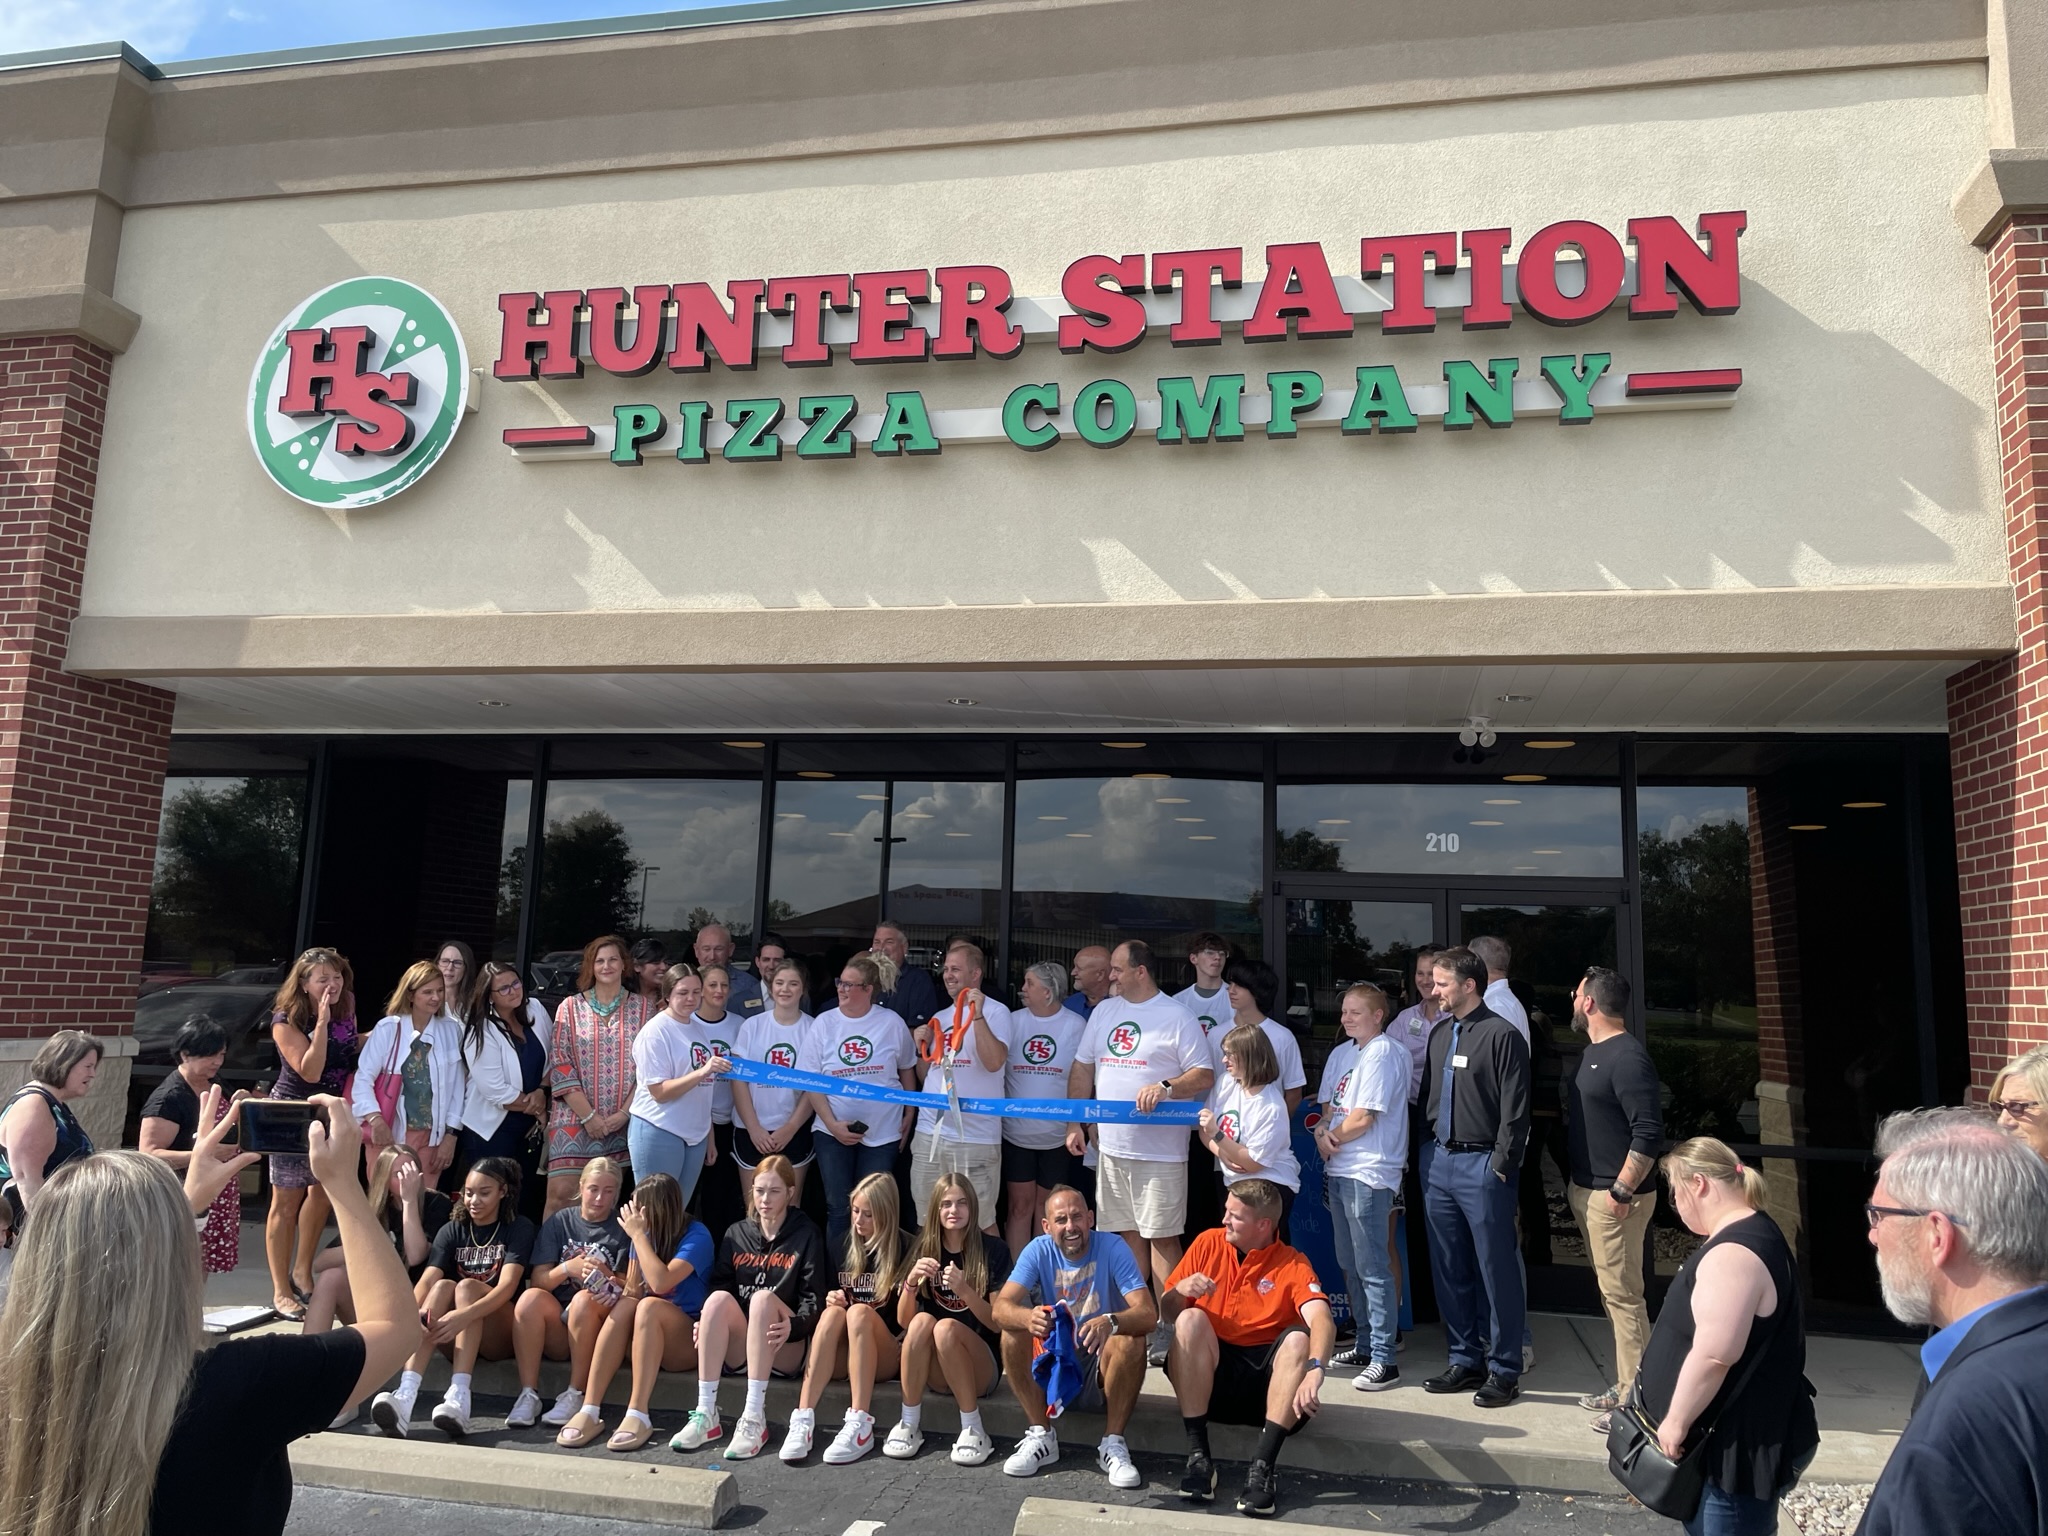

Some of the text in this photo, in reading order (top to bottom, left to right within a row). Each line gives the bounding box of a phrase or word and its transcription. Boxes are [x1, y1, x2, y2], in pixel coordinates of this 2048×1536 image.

[493, 211, 1747, 381] HUNTER STATION
[278, 325, 418, 456] HS
[610, 352, 1611, 466] PIZZA COMPANY
[1425, 832, 1460, 853] 210
[1113, 1028, 1135, 1051] HS
[844, 1042, 868, 1059] HS
[1029, 1041, 1050, 1059] HS
[856, 1065, 885, 1073] STATION
[1037, 1066, 1063, 1074] STATION
[1121, 1058, 1148, 1066] STATION
[767, 1070, 832, 1089] Congratulations
[1005, 1104, 1073, 1115] Congratulations
